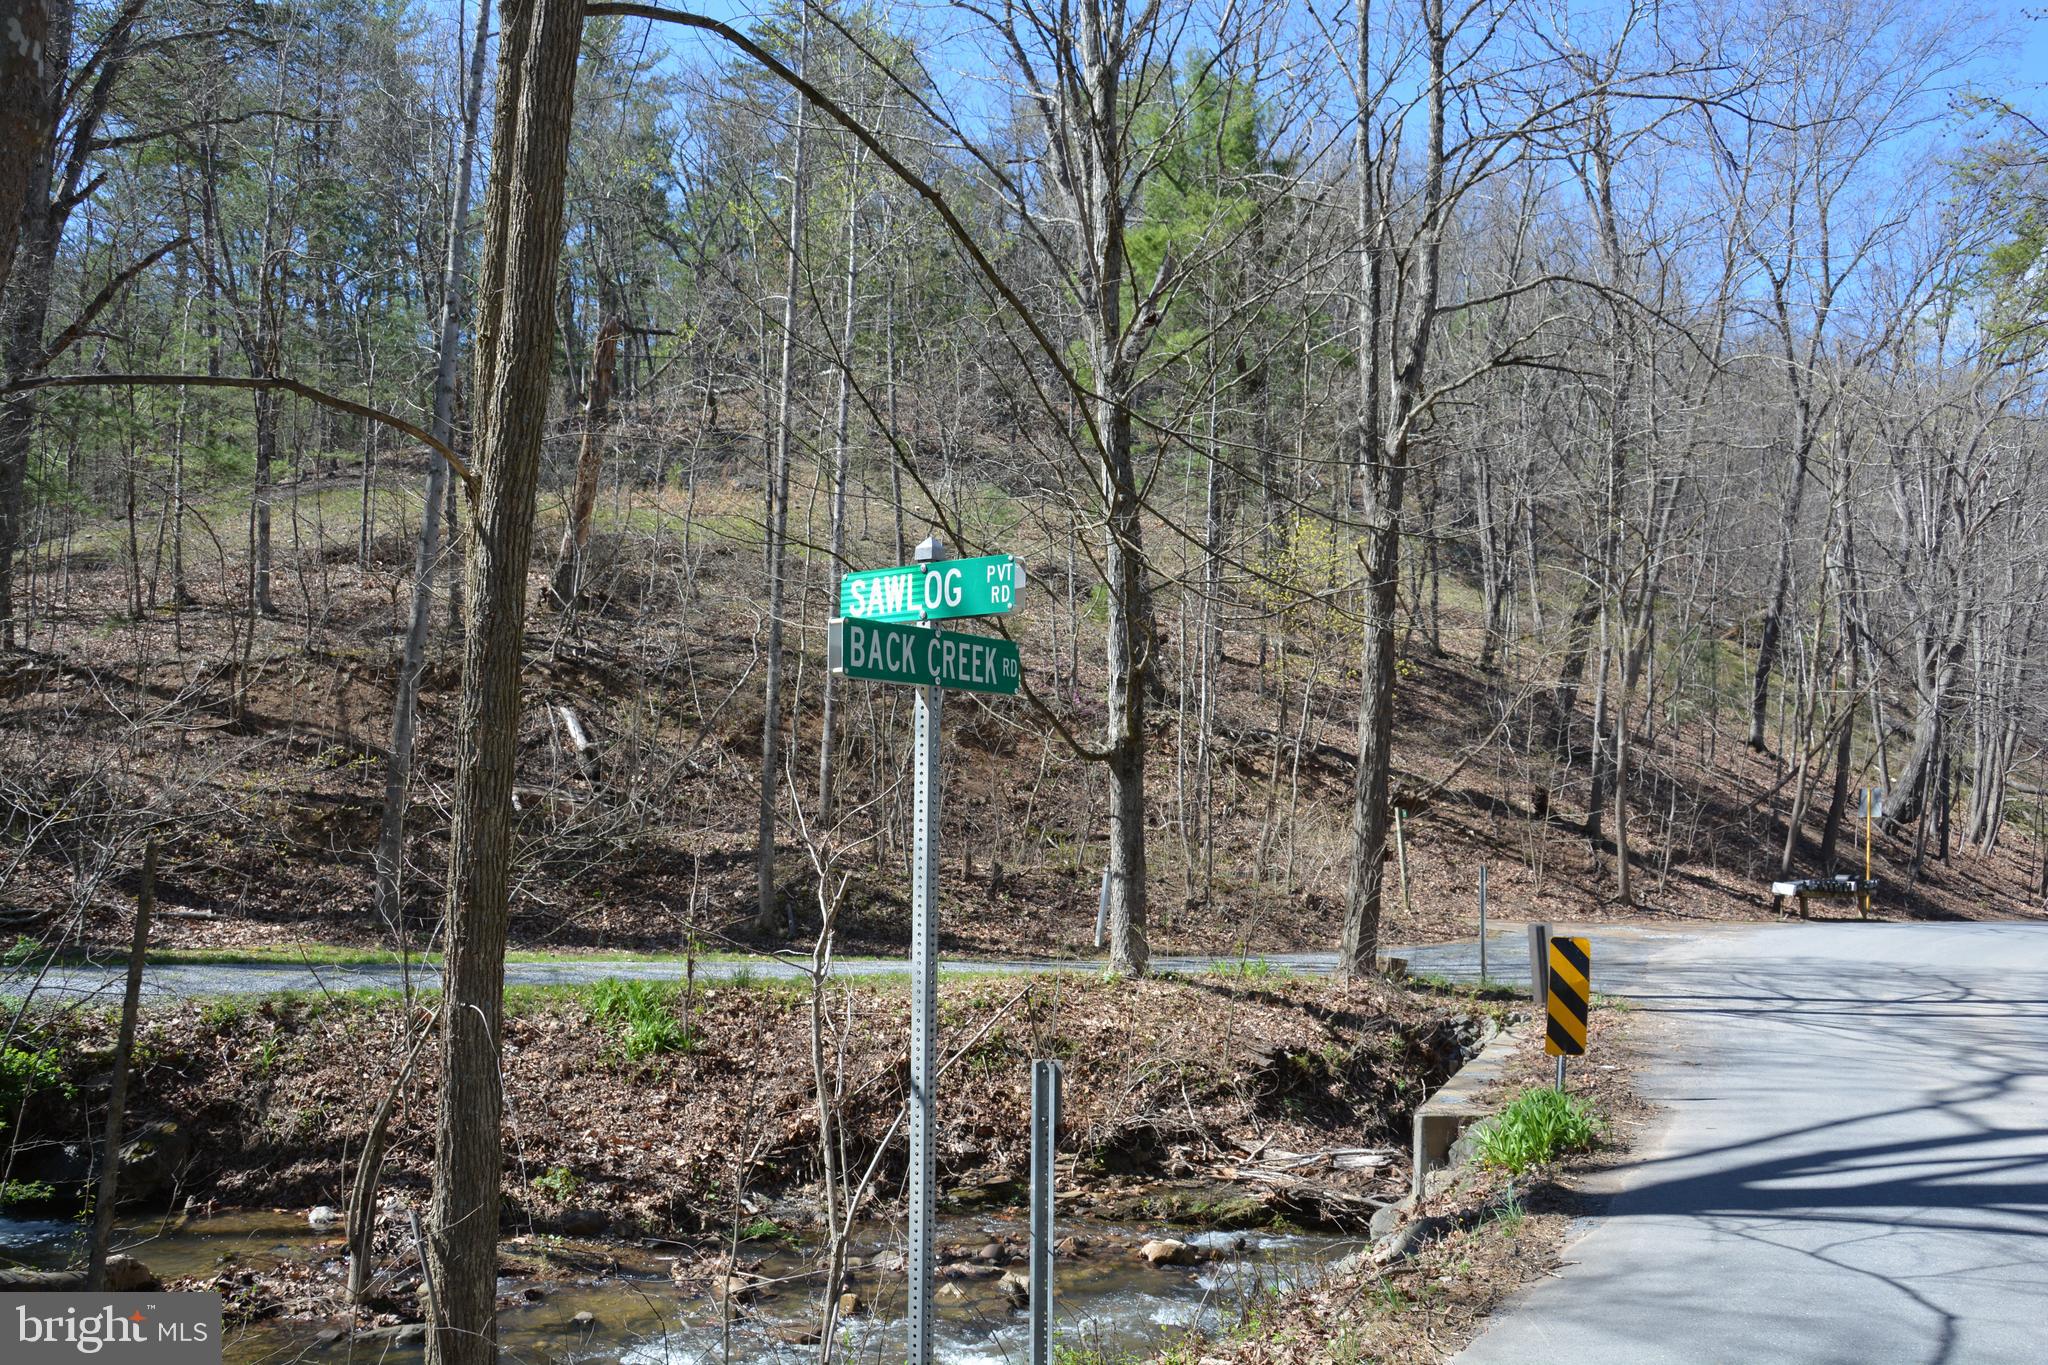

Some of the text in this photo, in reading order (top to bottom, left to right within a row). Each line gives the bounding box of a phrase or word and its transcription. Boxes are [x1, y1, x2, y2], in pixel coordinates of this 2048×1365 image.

[987, 563, 1013, 583] PVT
[850, 568, 962, 617] SAWLOG
[991, 585, 1010, 603] RD
[850, 626, 1018, 684] BACK CREEK RD
